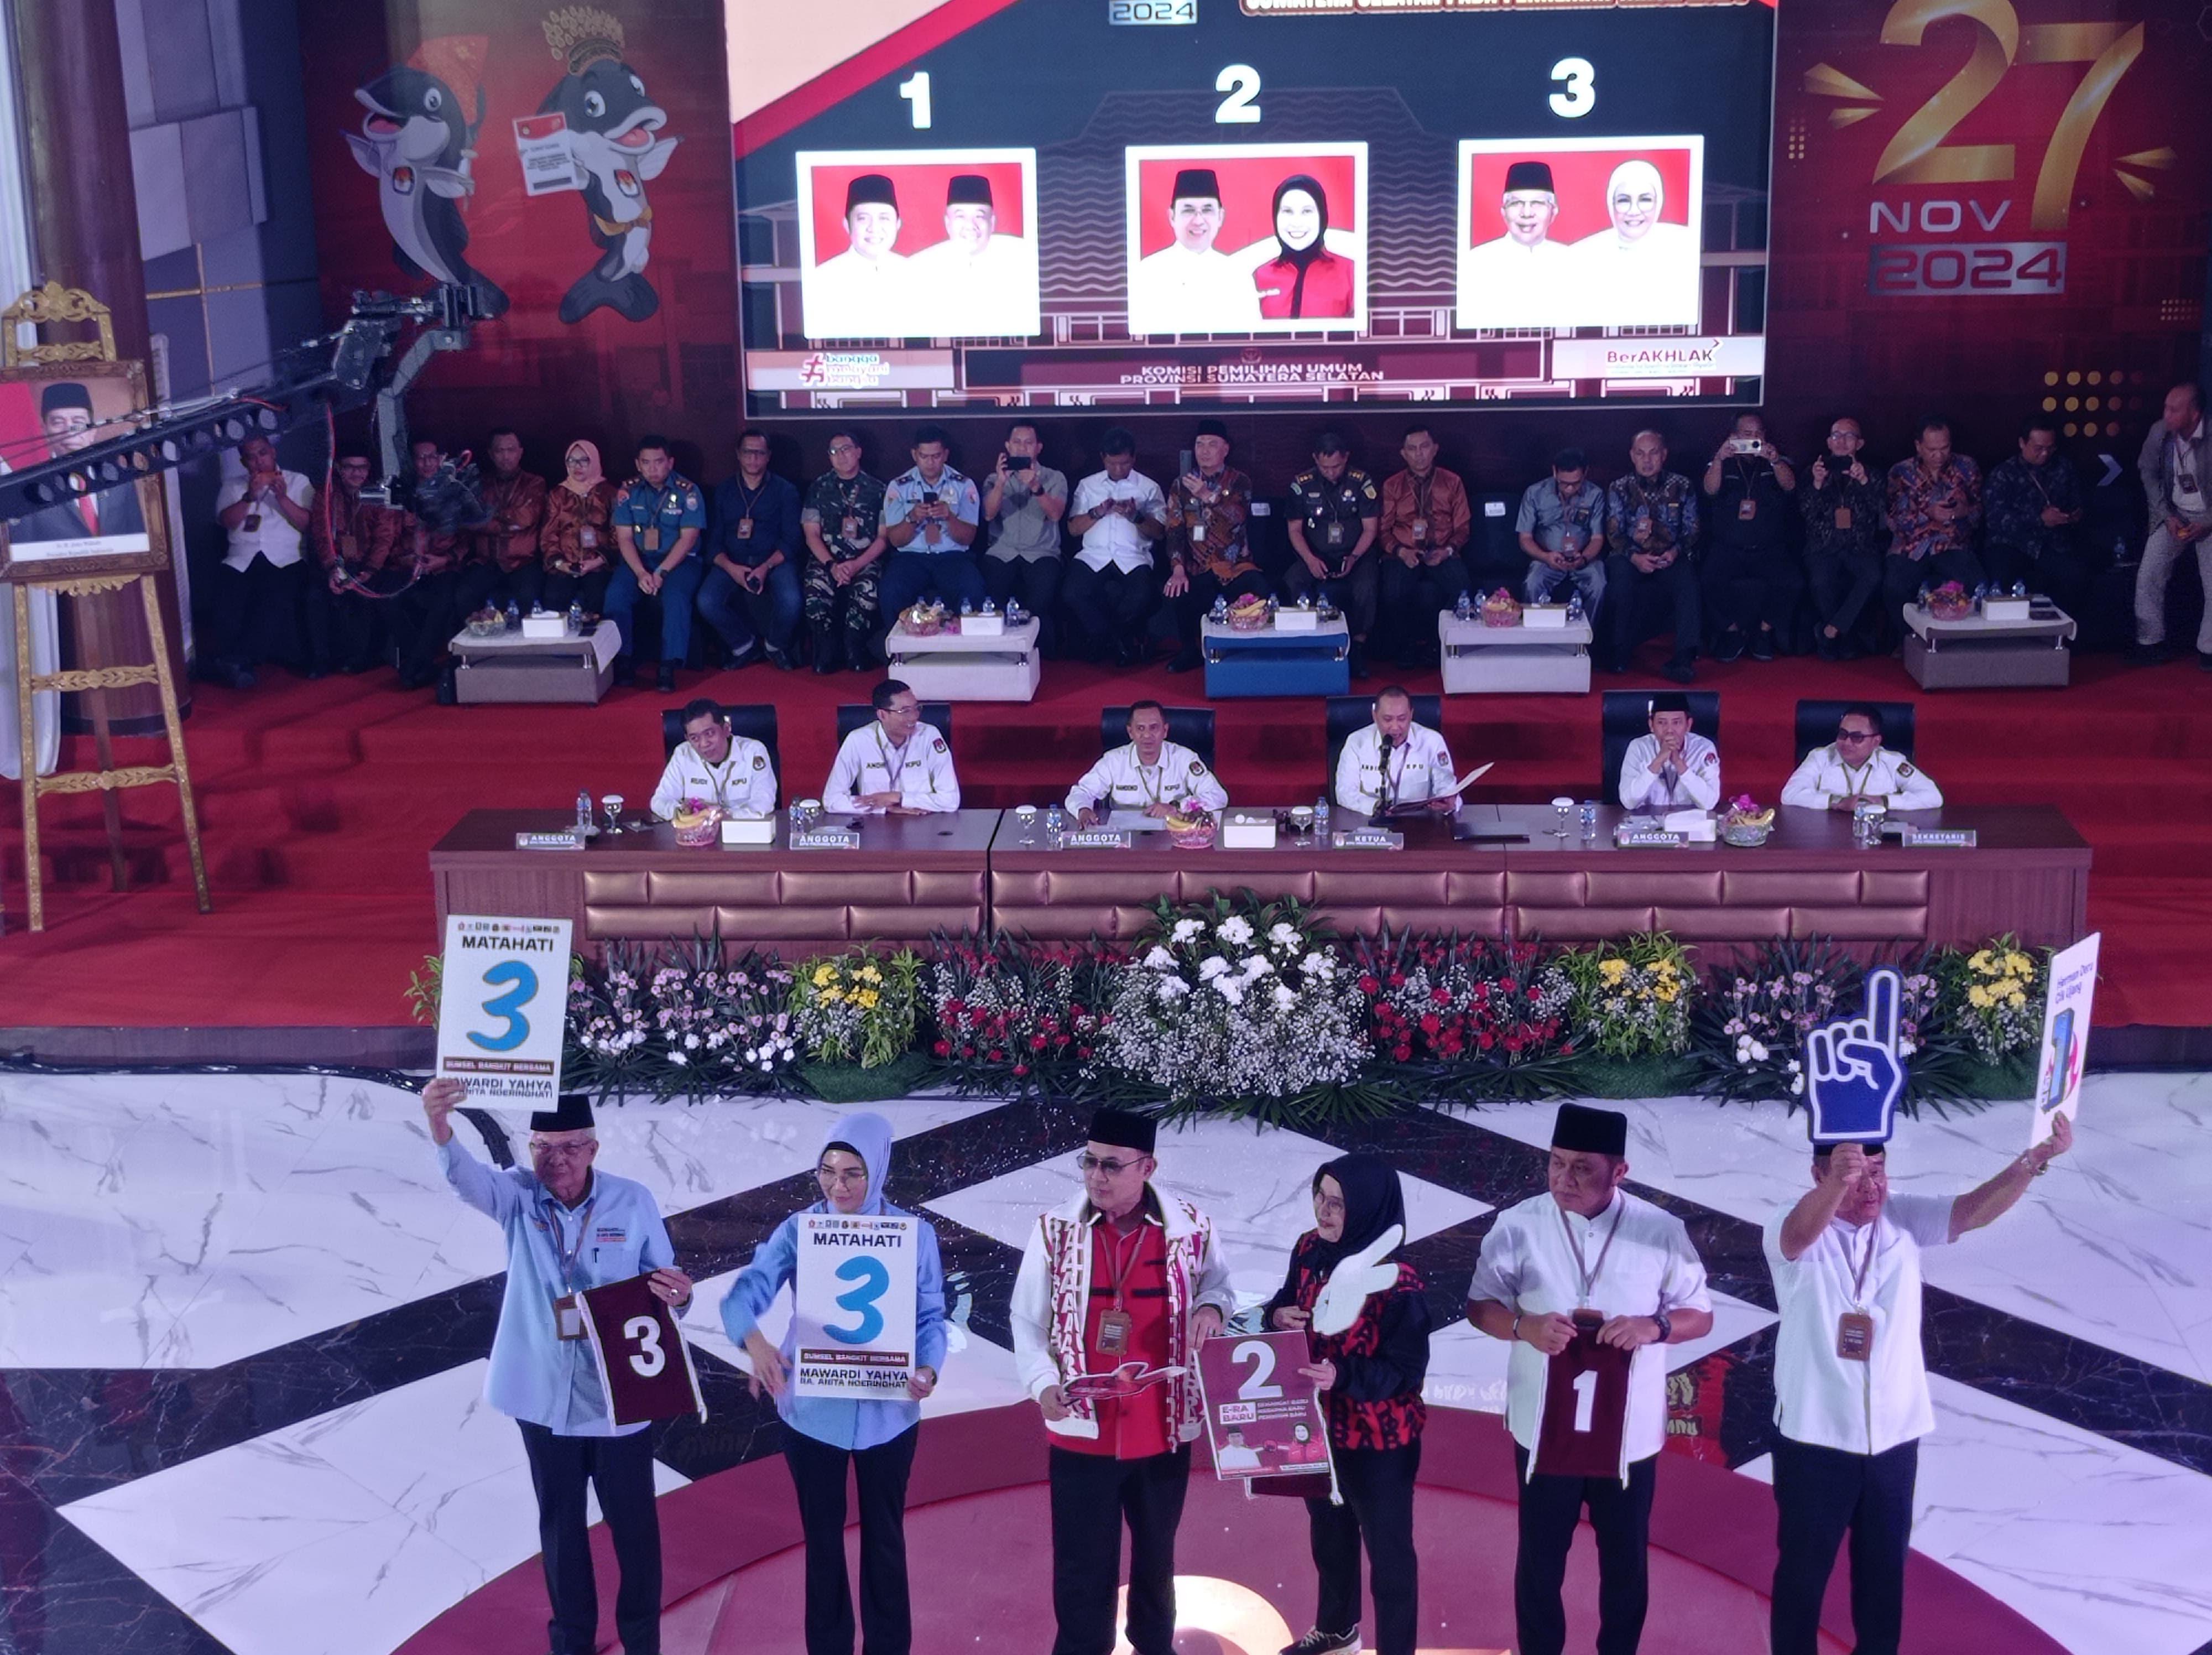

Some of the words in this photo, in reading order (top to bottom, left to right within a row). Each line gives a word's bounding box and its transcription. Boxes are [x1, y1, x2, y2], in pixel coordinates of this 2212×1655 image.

[1113, 3, 1194, 20] 2024
[899, 71, 931, 129] 1
[1215, 65, 1261, 124] 2
[1549, 58, 1596, 118] 3
[1872, 0, 2145, 230] 27
[1870, 199, 2012, 233] NOV
[1875, 248, 2062, 290] 2024
[1142, 366, 1202, 375] KOMISI
[1207, 364, 1302, 374] PEMILIHAN
[1306, 363, 1363, 373] UMUM
[1607, 349, 1713, 363] BerAKHLAK
[1120, 374, 1202, 384] PROVINSI
[1206, 373, 1301, 383] SUMATERA
[1306, 371, 1384, 381] SELATAN
[462, 935, 554, 953] MATAHATI
[466, 959, 539, 1052] 3
[509, 1079, 553, 1091] YAHYA
[813, 1232, 902, 1248] MATAHATI
[823, 1255, 890, 1345] 3
[623, 1315, 666, 1378] 3
[800, 1367, 860, 1378] MAWARDI
[866, 1370, 909, 1381] YAHYA
[848, 1380, 906, 1388] NOERINGHAT
[1232, 1340, 1284, 1400] 2
[1573, 1370, 1598, 1433] 1
